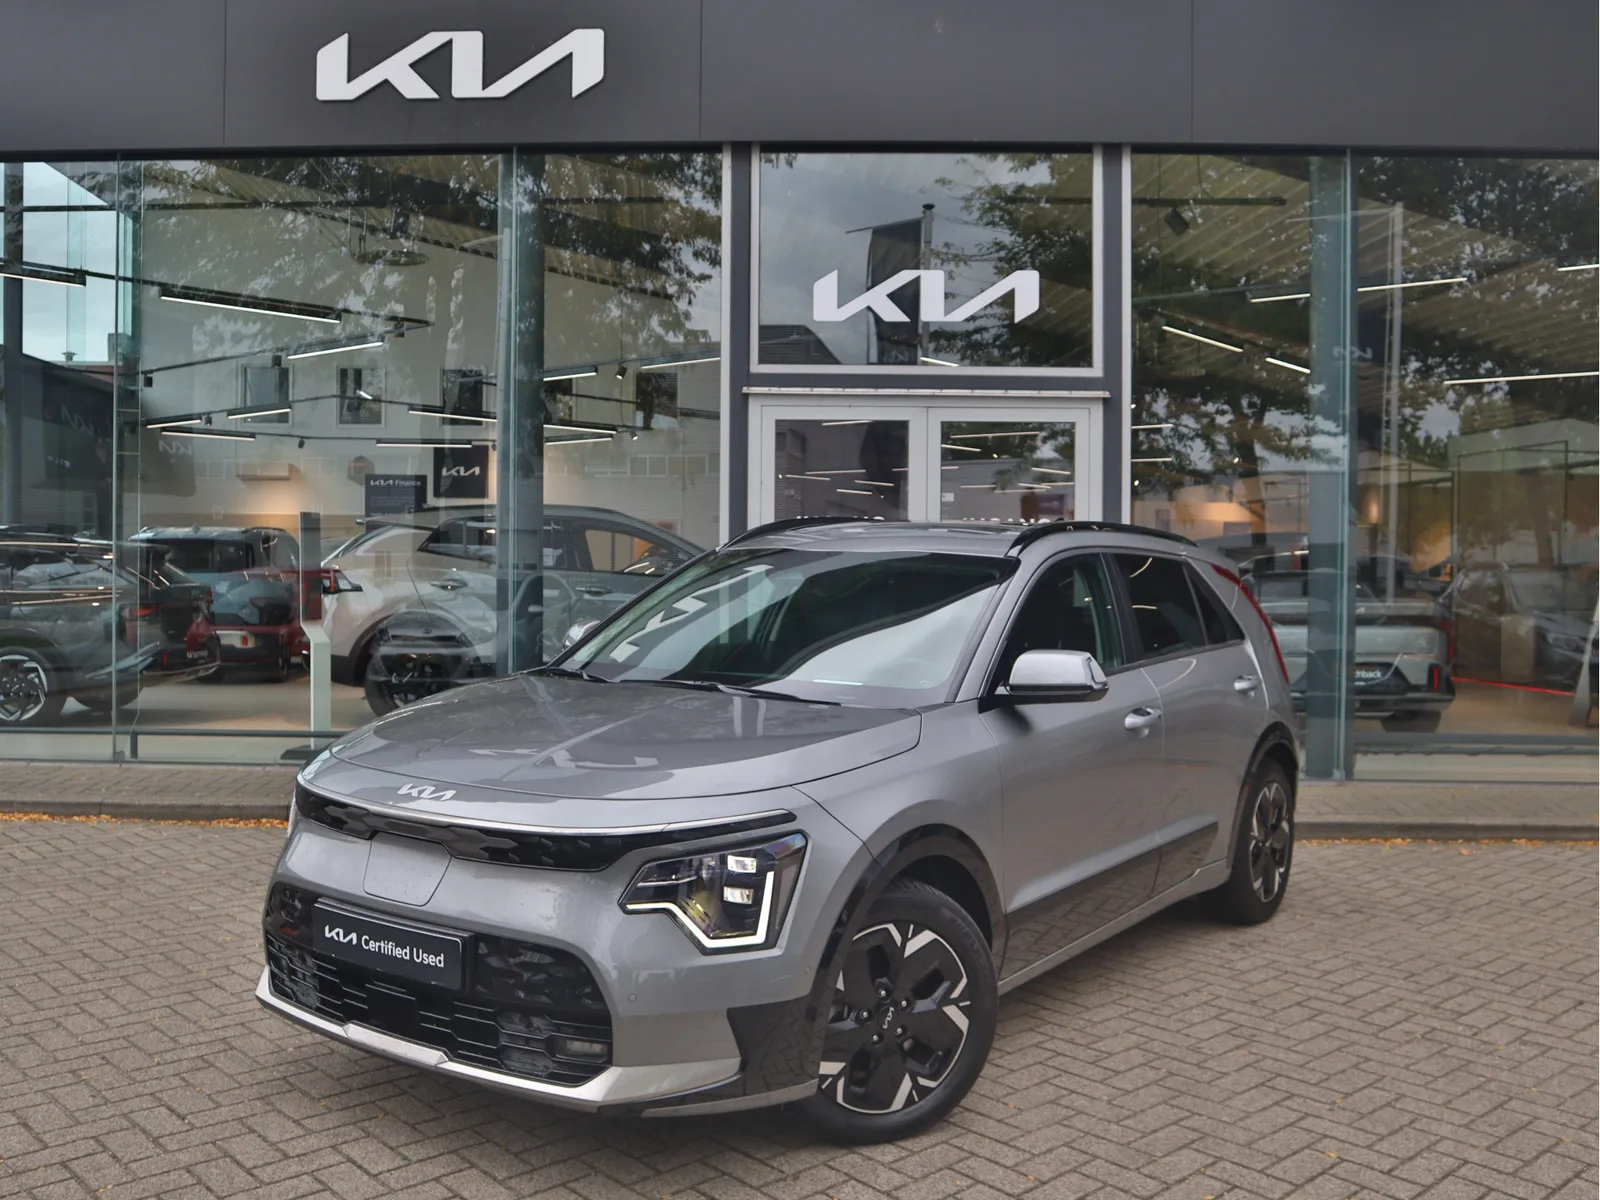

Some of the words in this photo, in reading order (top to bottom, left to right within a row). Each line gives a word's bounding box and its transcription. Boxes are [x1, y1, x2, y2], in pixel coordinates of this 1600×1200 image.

[316, 28, 604, 100] KIA
[813, 269, 1040, 324] KIA
[442, 466, 480, 476] KIA
[397, 783, 456, 801] KIA
[324, 925, 358, 945] KIA
[361, 935, 410, 960] Certified
[413, 947, 444, 968] Used
